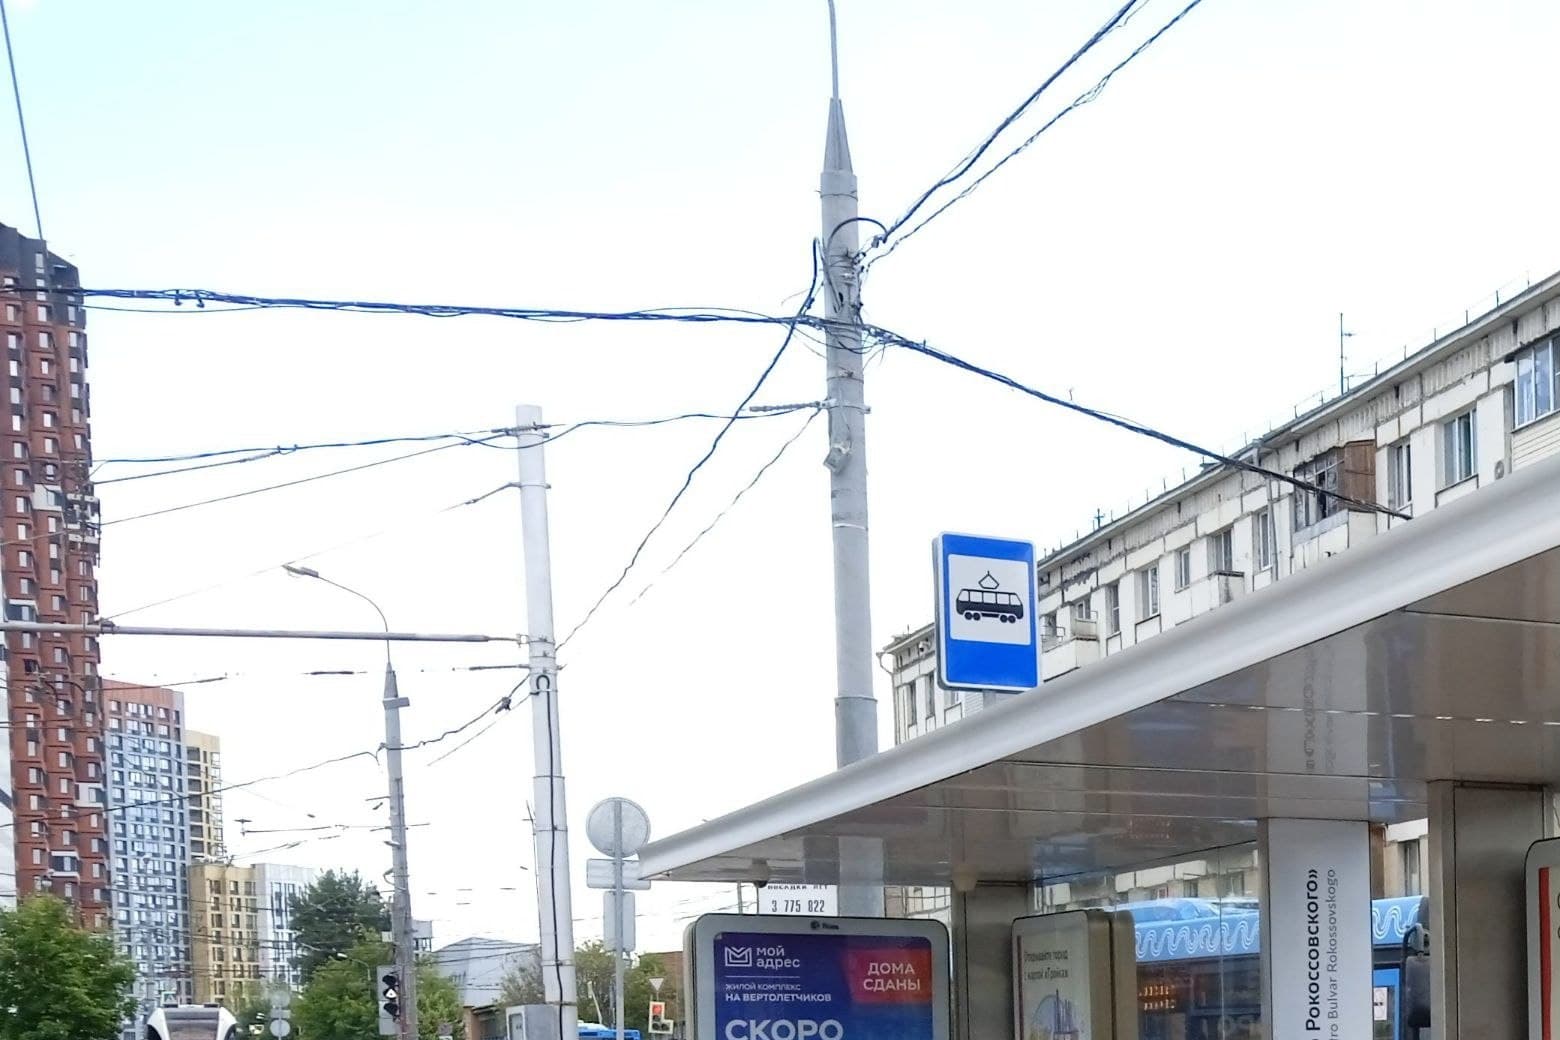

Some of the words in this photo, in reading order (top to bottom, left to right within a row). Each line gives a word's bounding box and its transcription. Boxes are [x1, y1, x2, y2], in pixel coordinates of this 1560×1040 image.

[784, 899, 801, 913] 775
[1325, 869, 1340, 973] Rokossovskogo
[756, 945, 785, 957] мой
[1305, 869, 1321, 1031] Рокоссовского»
[756, 958, 801, 971] адрес
[867, 962, 916, 977] ДОМА
[862, 978, 921, 992] СДАНЫ
[742, 993, 832, 1002] ВЕРТОЛЕТЧИКОВ
[1327, 978, 1339, 1019] Bulvar
